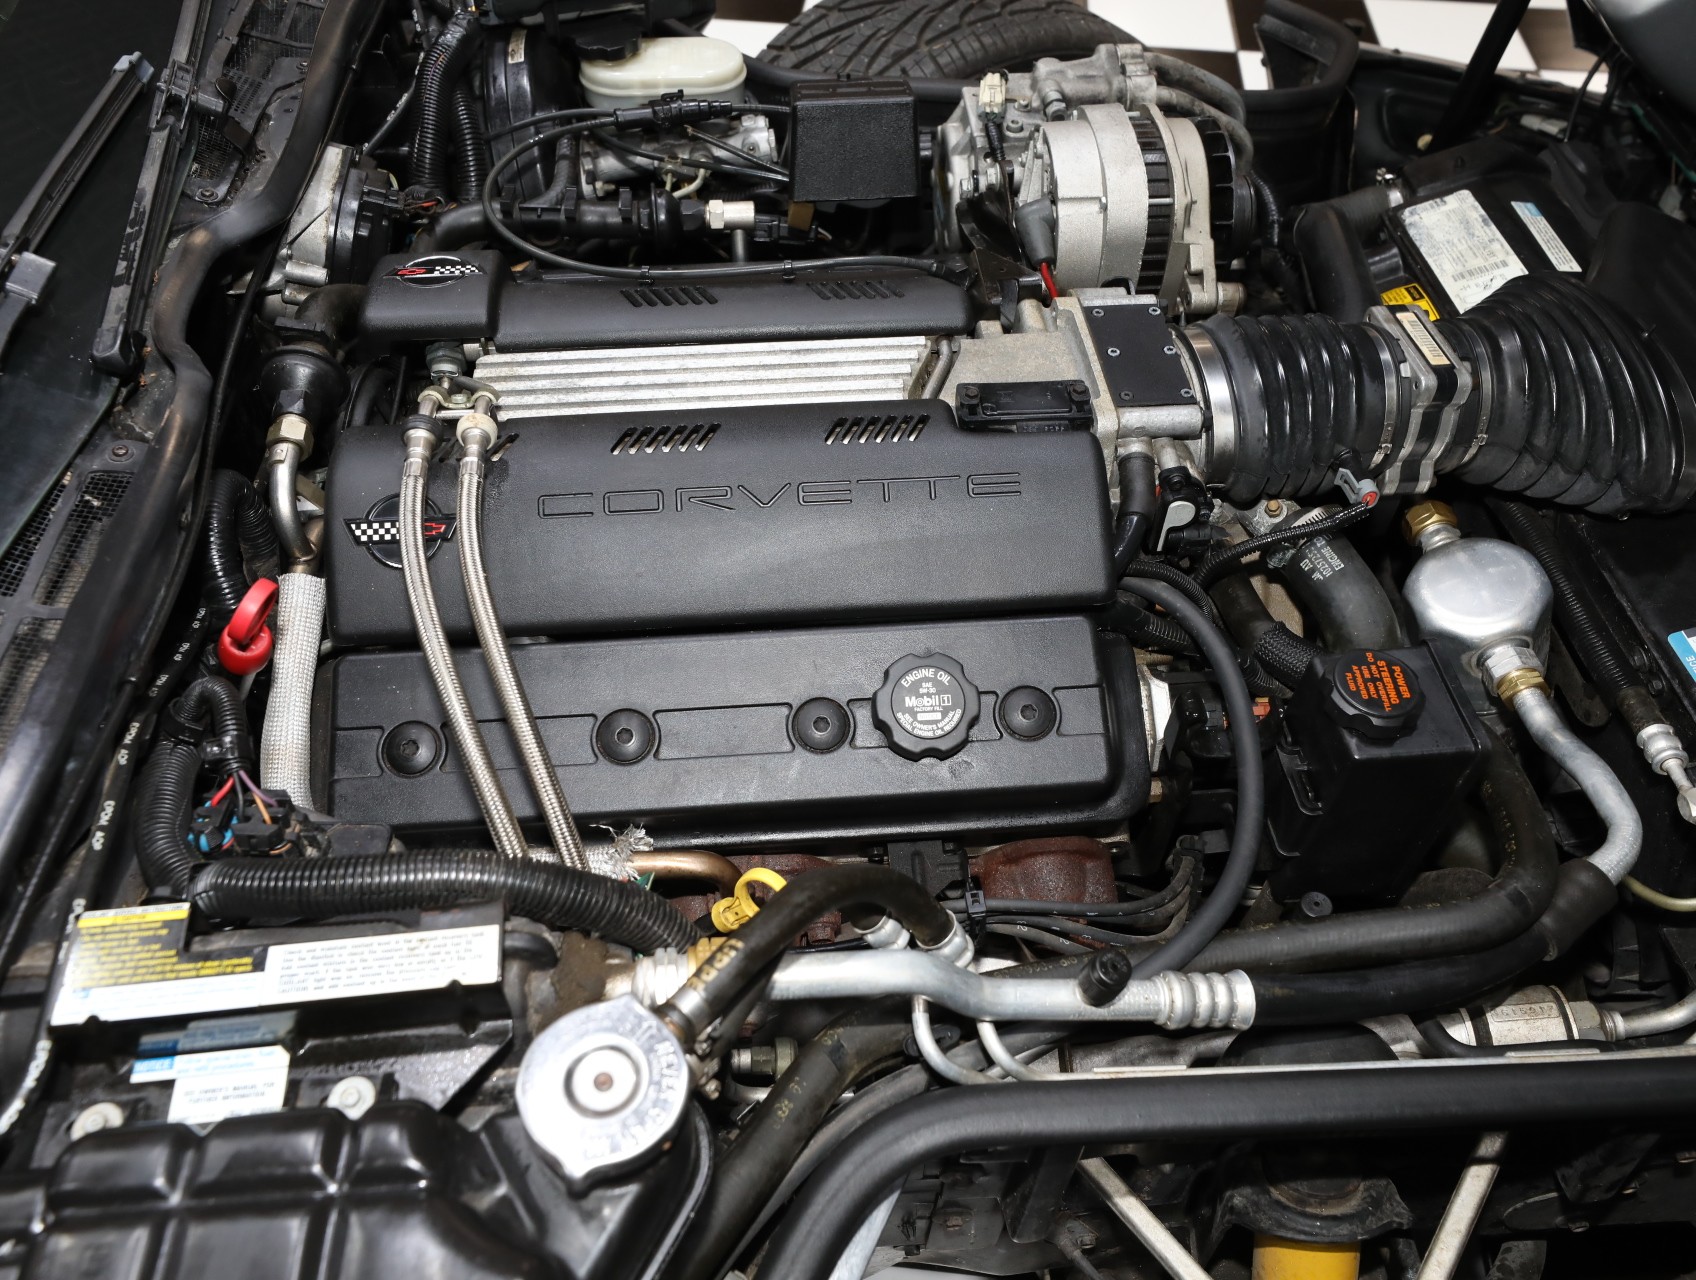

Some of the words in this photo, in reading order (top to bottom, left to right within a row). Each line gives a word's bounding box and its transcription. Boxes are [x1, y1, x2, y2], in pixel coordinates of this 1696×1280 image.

[538, 472, 1021, 519] CORVETTE
[1321, 546, 1345, 570] ENGINE
[901, 668, 935, 687] ENGINE
[937, 671, 952, 685] OIL
[1345, 672, 1357, 691] FLUID
[1352, 665, 1369, 700] APPROVED
[1361, 665, 1371, 679] USE
[1367, 682, 1379, 699] ONLY
[1366, 652, 1374, 662] DO
[1370, 664, 1380, 678] NOT
[1376, 681, 1392, 712] OVERFILL
[1377, 660, 1400, 704] STEERING
[1391, 665, 1411, 699] POWER
[904, 695, 939, 707] Mobil
[896, 711, 913, 731] SPECIAL
[913, 728, 934, 737] ENGINE
[934, 728, 945, 736] OIL
[943, 708, 962, 731] REQUIRED
[903, 713, 914, 724] SEE
[912, 721, 938, 731] OWNER'S
[936, 710, 956, 728] MANUAL
